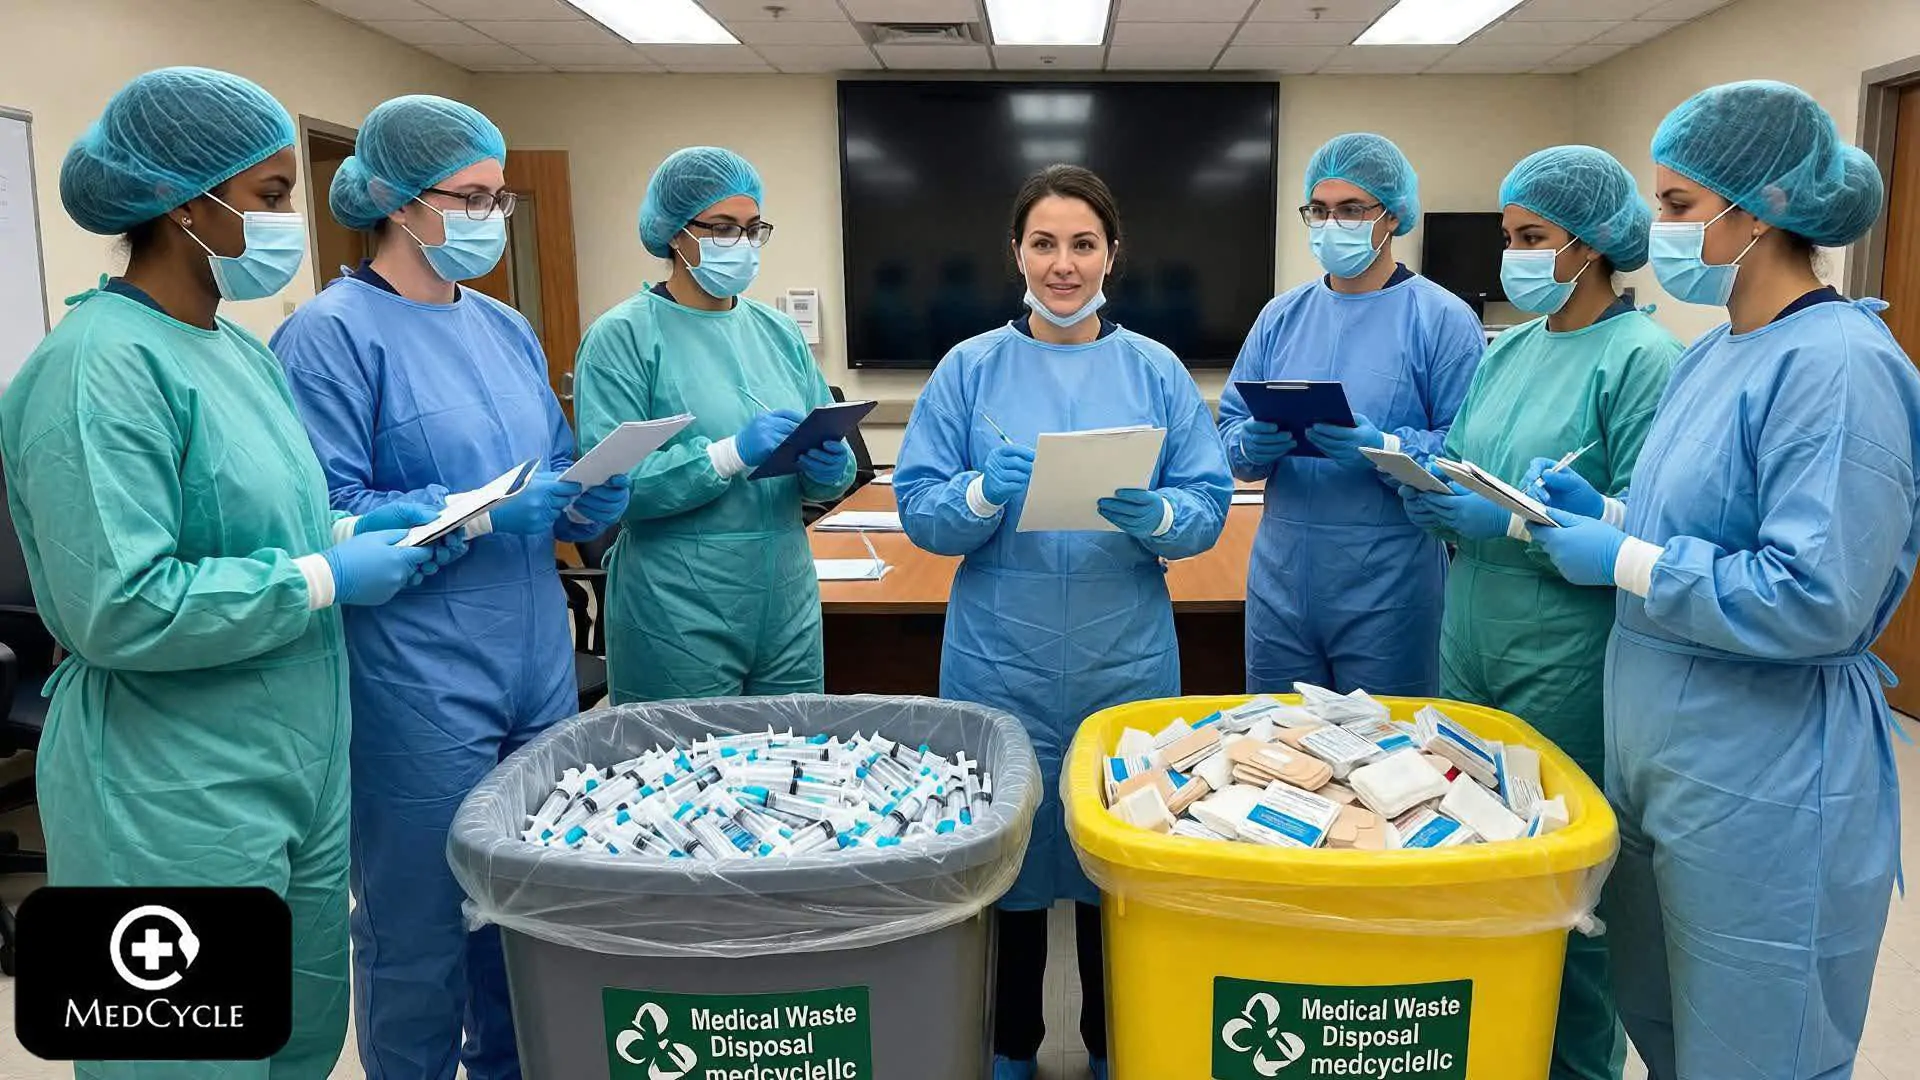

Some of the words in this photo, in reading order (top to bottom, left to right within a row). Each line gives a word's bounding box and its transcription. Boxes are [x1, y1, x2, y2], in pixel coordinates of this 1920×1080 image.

[691, 1008, 779, 1031] Medical
[786, 1004, 857, 1028] Waste
[1302, 998, 1388, 1020] Medical
[1394, 996, 1461, 1019] Waste
[711, 1032, 813, 1062] Disposal
[1323, 1023, 1420, 1051] Disposal
[1311, 1049, 1453, 1079] medcyclellc
